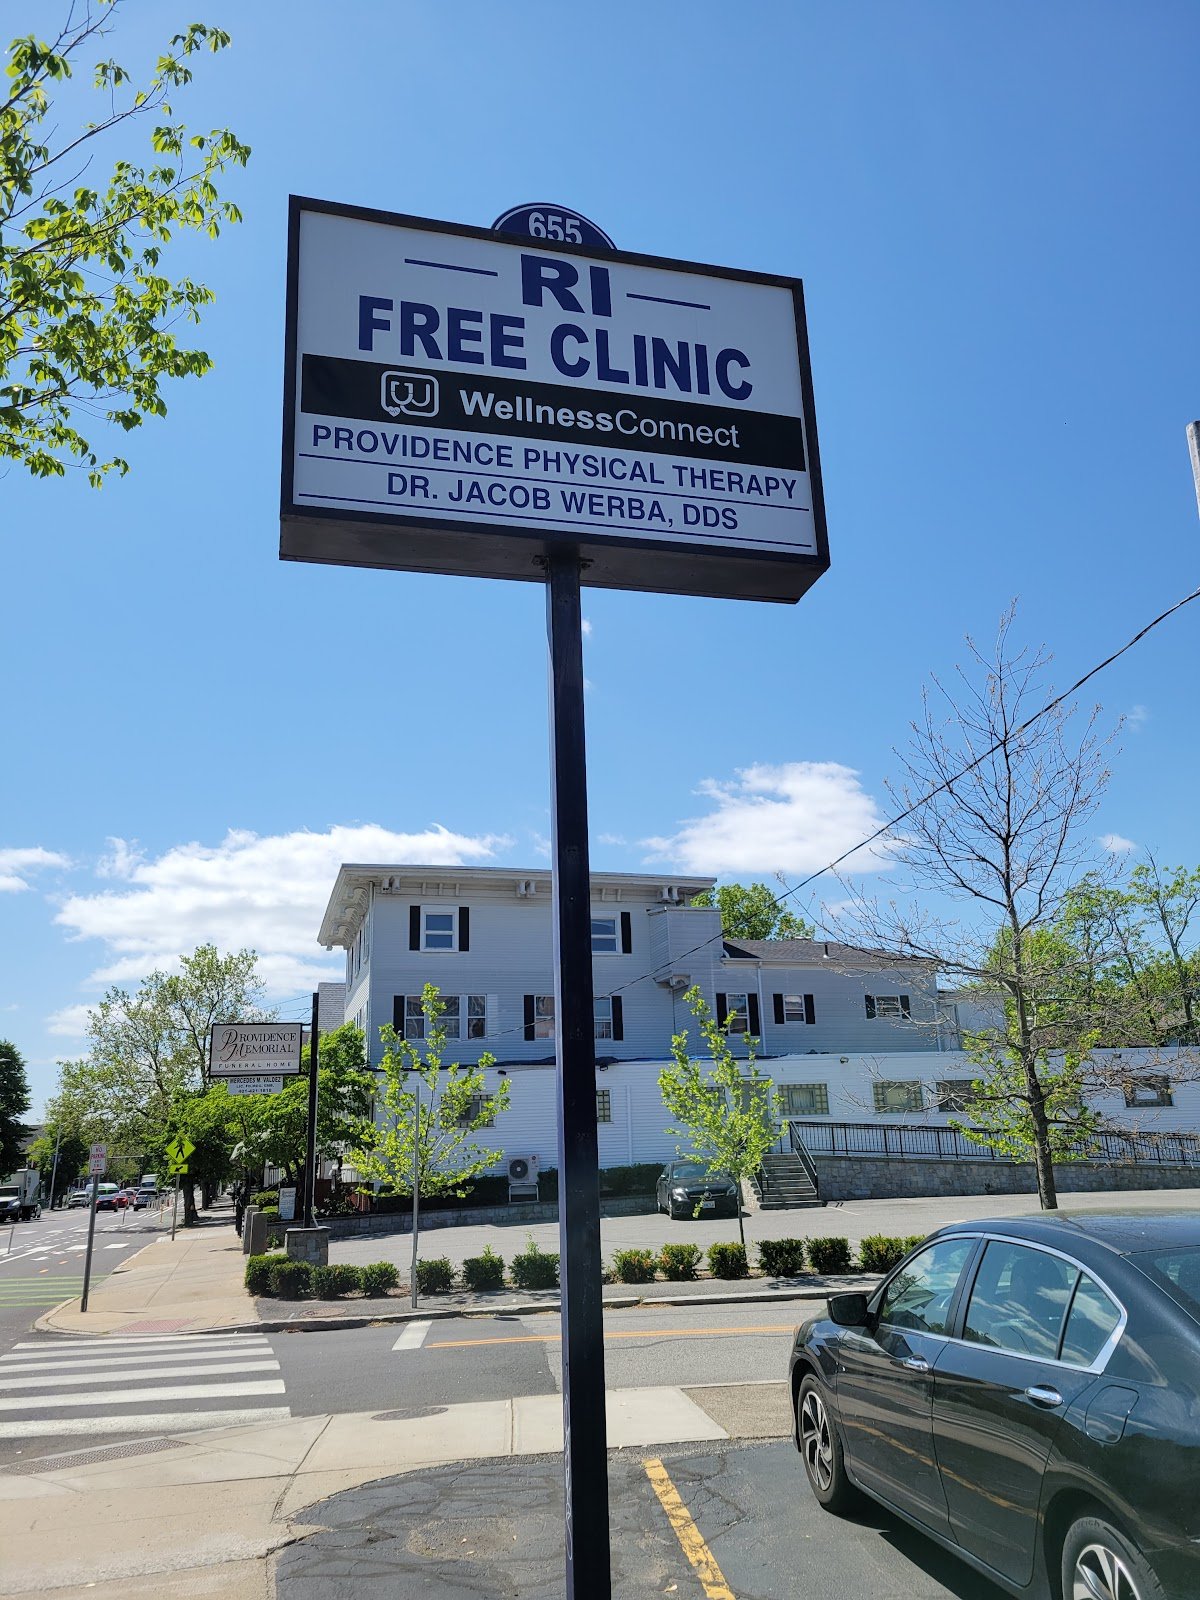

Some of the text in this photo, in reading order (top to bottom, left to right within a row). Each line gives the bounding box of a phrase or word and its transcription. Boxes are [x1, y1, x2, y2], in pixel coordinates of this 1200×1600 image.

[528, 211, 583, 245] 655
[520, 253, 612, 318] RI
[358, 295, 753, 401] FREE CLINIC
[459, 389, 740, 448] WellnessConnect
[312, 424, 798, 499] PROVIDENCE PHYSICAL THERAPY
[387, 472, 739, 531] DR. JACOB WERBA, DDS
[216, 1028, 297, 1051] PROVIDENCE
[220, 1043, 295, 1062] MEMORIAL
